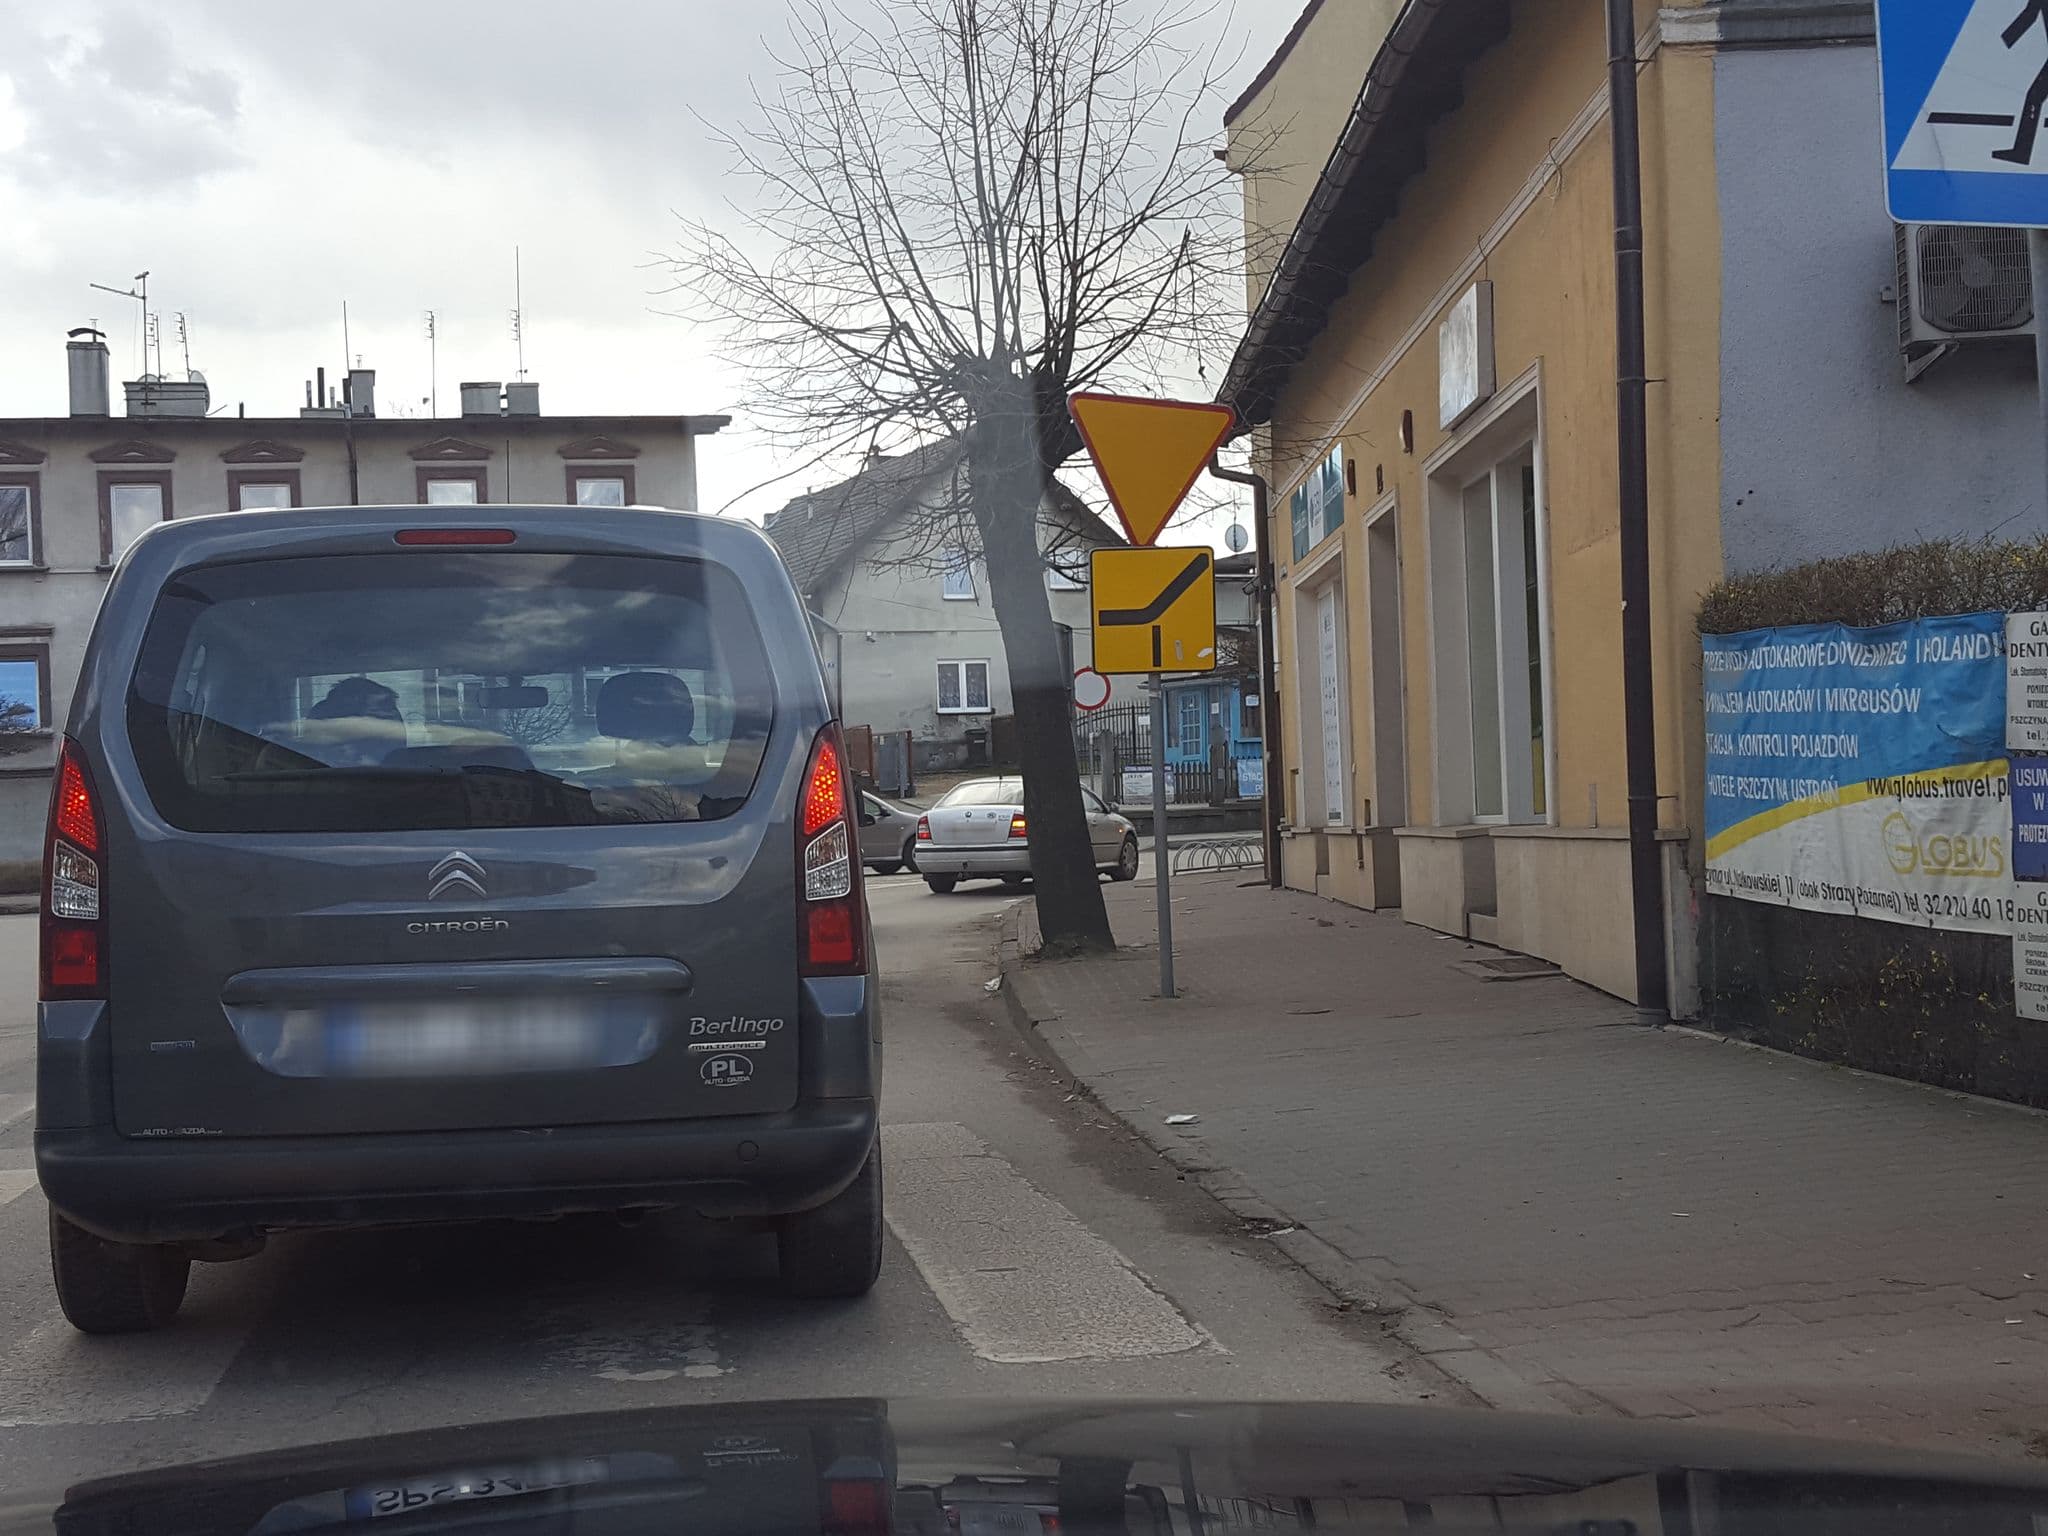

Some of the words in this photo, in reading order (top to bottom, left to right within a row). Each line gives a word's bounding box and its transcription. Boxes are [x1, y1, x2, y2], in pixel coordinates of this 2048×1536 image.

[1748, 643, 1825, 670] AUTOKAROWE
[1915, 637, 1920, 664] I
[1745, 684, 1814, 713] AUTOKARÓW
[1738, 734, 1788, 757] KONTROLI
[1791, 730, 1859, 759] POJAZDÓW
[1737, 776, 1789, 801] PSZCZYNA
[1791, 775, 1840, 805] USTROŃ
[2033, 792, 2045, 811] W
[1882, 811, 2005, 878] GLOBUS
[1923, 894, 1942, 915] 32
[1972, 897, 1991, 919] 40
[1997, 898, 2014, 921] 18
[690, 1016, 784, 1036] Berlingo
[711, 1060, 744, 1077] PL
